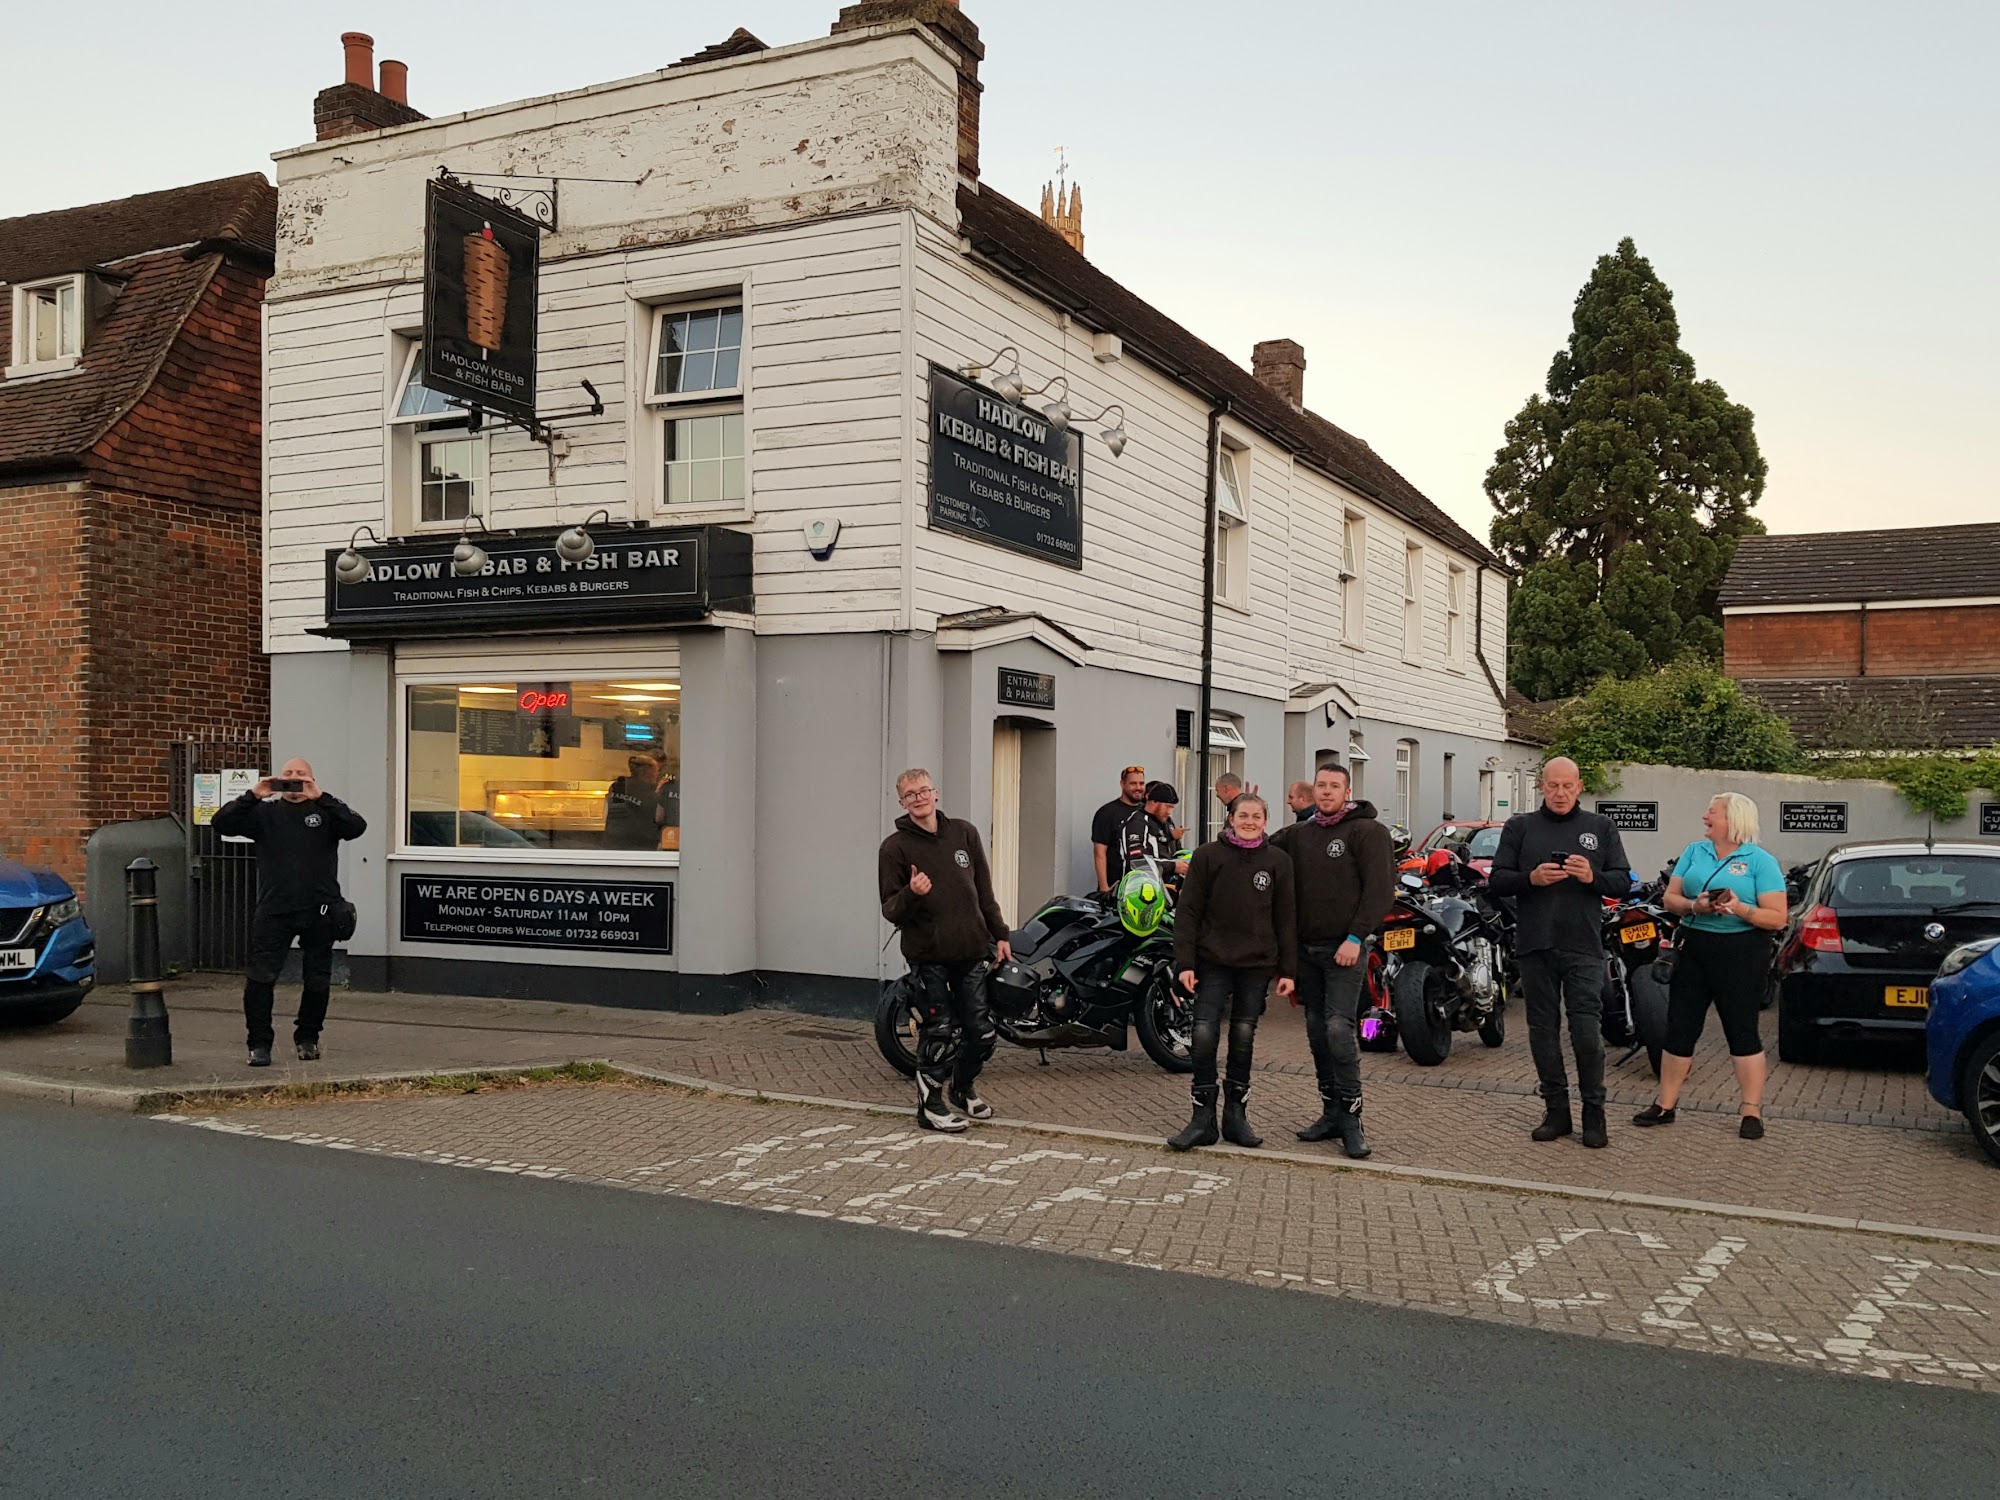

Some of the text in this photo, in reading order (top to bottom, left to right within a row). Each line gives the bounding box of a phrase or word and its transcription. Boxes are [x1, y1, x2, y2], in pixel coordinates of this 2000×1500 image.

[441, 350, 525, 386] HADLOW KEBAB
[455, 368, 512, 395] & FISH BAR
[979, 398, 1047, 445] HADLOW
[939, 412, 1079, 489] KEBAB & FISH BAR
[953, 452, 1010, 487] TRADITIONAL
[1011, 474, 1031, 494] FISH
[1031, 483, 1038, 497] &
[936, 493, 970, 512] CUSTOMER
[969, 479, 1051, 520] KEBABS & BURGERS
[939, 505, 967, 523] PARKING
[1036, 532, 1076, 553] 01732 669031
[362, 562, 442, 582] ADLOW
[450, 558, 528, 578] BAB
[536, 556, 552, 573] &
[627, 549, 679, 568] BAR
[393, 590, 455, 602] TRADITIONAL
[457, 588, 480, 598] FISH
[481, 587, 490, 597] &
[527, 582, 567, 595] KEBABS
[569, 582, 578, 592] &
[580, 581, 629, 592] BURGERS
[1007, 675, 1048, 690] ENTRANCE
[520, 691, 568, 714] Open
[1006, 686, 1049, 703] & PARKING
[1616, 820, 1650, 828] RKING
[1783, 813, 1845, 821] CUSTOMER
[1789, 821, 1839, 829] PARKING
[416, 884, 655, 907] WE ARE OPEN 6 DAYS A WEEK
[438, 904, 486, 917] MONDAY
[493, 906, 554, 920] SATURDAY
[558, 909, 588, 921] 11AM
[598, 910, 630, 923] 10PM
[424, 921, 640, 941] TELEPHONE ORDERS WELCOME 01732 669031
[0, 952, 26, 966] WML
[1896, 988, 1929, 1005] EJ1
